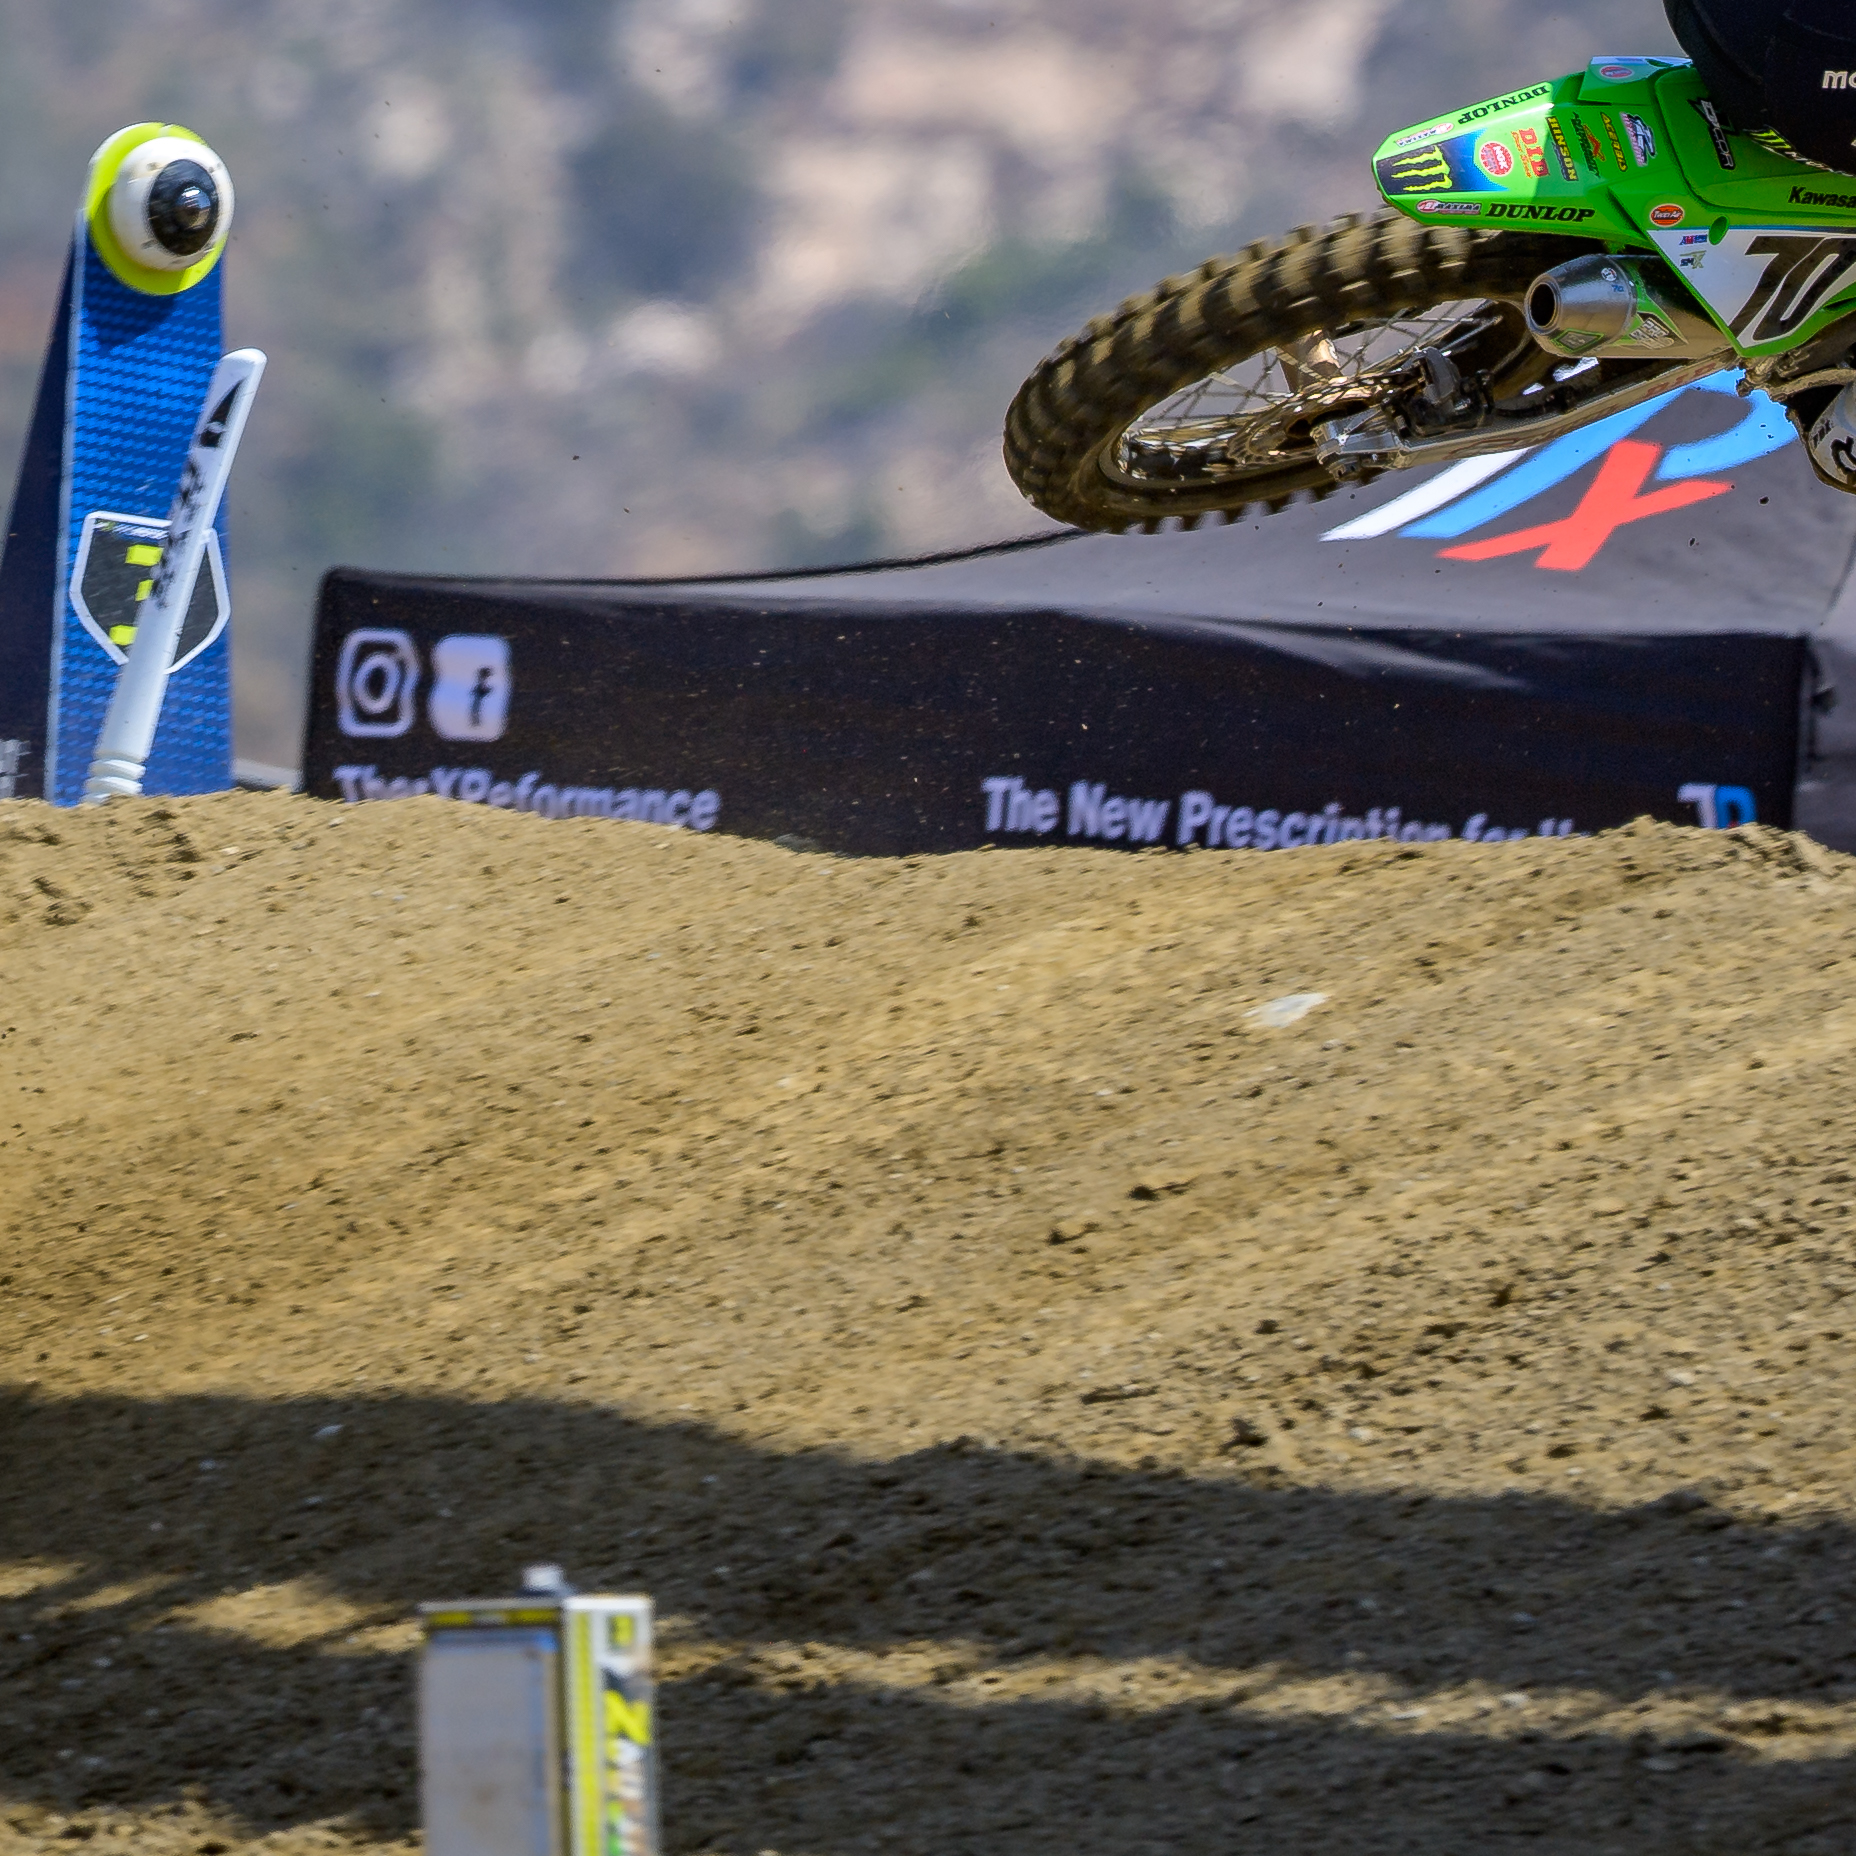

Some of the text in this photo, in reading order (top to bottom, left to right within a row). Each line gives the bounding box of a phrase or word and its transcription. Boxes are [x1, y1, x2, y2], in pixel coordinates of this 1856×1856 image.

[1457, 85, 1550, 125] DUNLOP
[1546, 116, 1578, 180] HINSON
[1484, 202, 1596, 223] DUNLOP
[981, 775, 1058, 833] The
[1067, 778, 1171, 842] New
